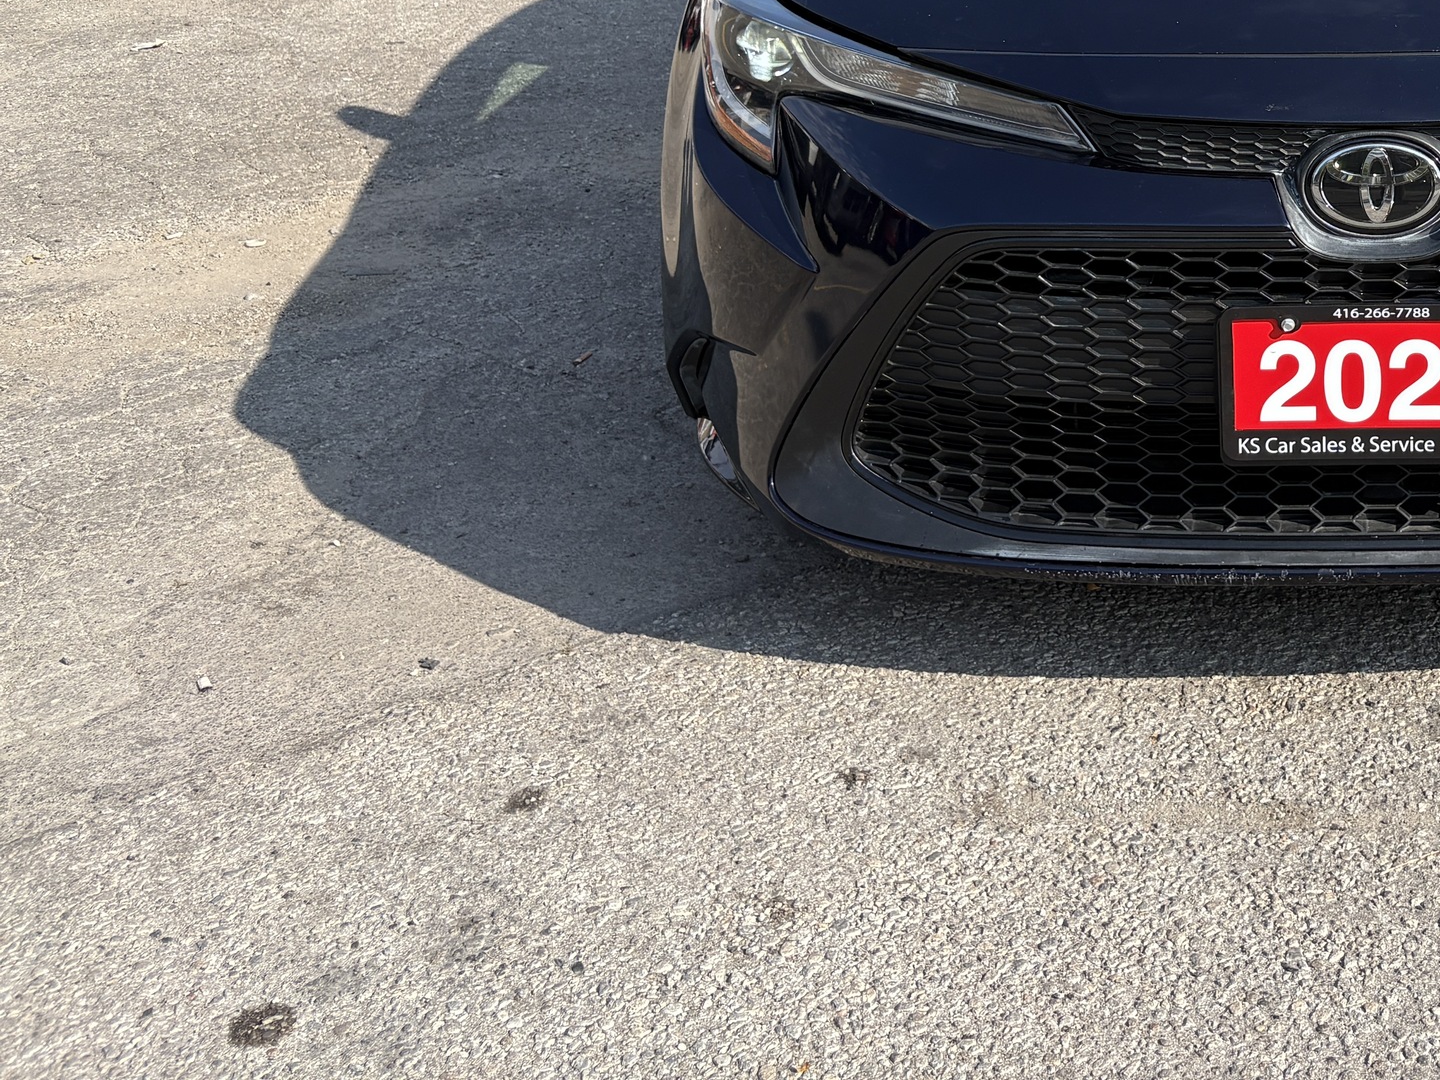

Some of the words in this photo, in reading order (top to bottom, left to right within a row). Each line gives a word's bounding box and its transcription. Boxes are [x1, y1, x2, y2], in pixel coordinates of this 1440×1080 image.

[1332, 307, 1430, 319] 416-266-7788
[1238, 437, 1260, 454] KS
[1265, 437, 1296, 454] Car
[1300, 436, 1347, 453] Sales
[1351, 436, 1365, 453] &
[1368, 436, 1435, 453] Service
